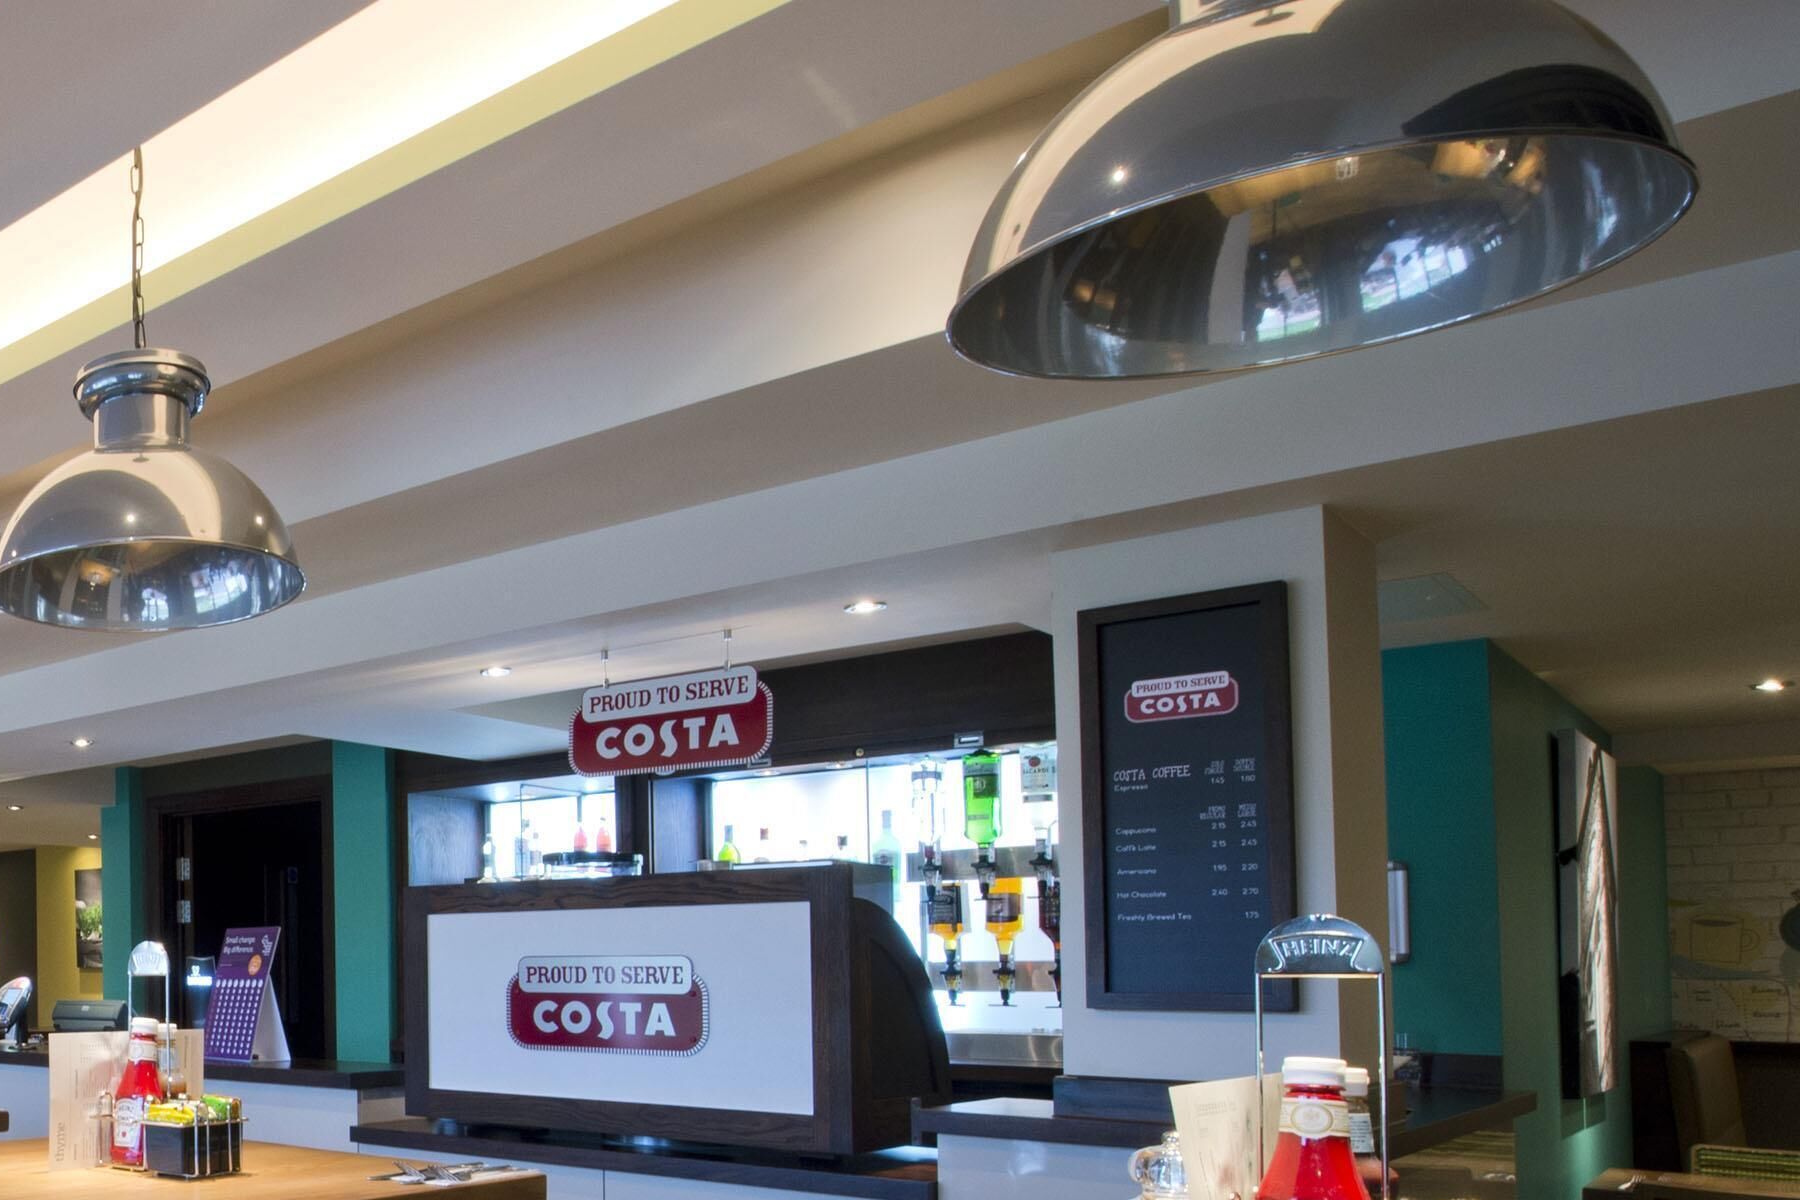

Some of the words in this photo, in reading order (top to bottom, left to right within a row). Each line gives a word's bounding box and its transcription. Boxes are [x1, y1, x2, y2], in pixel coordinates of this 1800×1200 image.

[589, 689, 652, 714] PROUD
[656, 685, 680, 705] TO
[685, 675, 749, 701] SERVE
[1136, 681, 1172, 694] PROUD
[1174, 679, 1188, 689] TO
[1190, 675, 1226, 688] SERVE
[1140, 691, 1221, 714] COSTA
[595, 713, 740, 760] COSTA
[1113, 769, 1146, 782] COSTA
[1152, 764, 1192, 779] COFFEE
[1281, 938, 1355, 957] HEINZ
[525, 966, 587, 984] PROUD
[592, 966, 616, 984] TO
[621, 966, 684, 985] SERVE
[533, 1000, 676, 1040] COSTA
